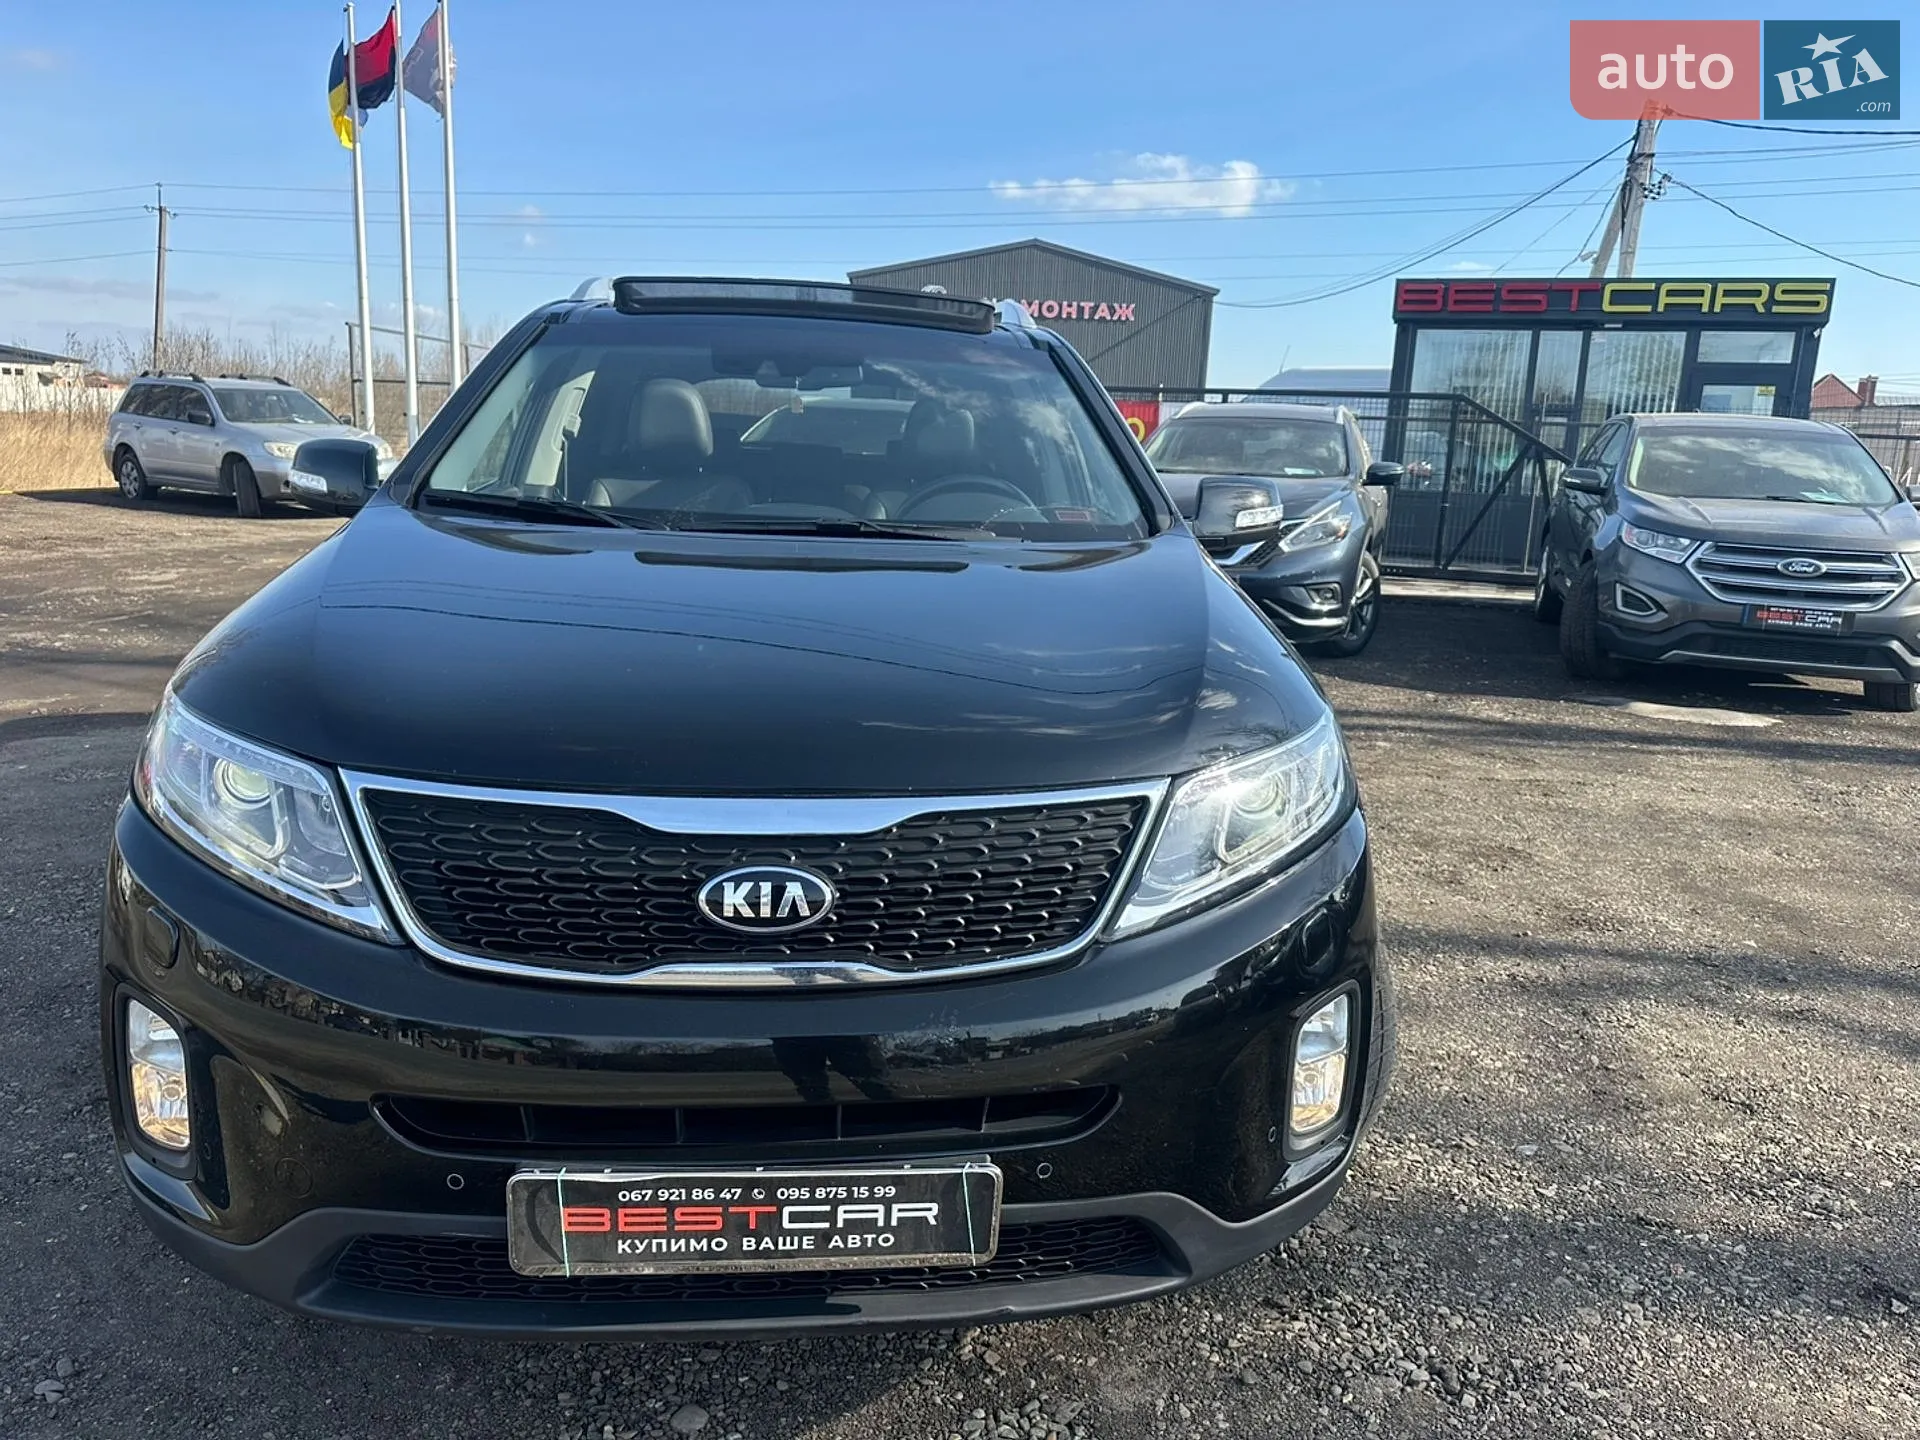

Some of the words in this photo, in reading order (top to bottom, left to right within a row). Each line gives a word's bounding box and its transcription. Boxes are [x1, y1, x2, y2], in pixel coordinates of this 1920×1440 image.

[984, 297, 1136, 321] МОНТАЖ
[1397, 282, 1831, 313] BESTCARS
[1788, 559, 1815, 573] Ford
[722, 881, 811, 918] KIA
[618, 1189, 653, 1202] 067
[657, 1188, 686, 1201] 921
[691, 1187, 715, 1200] 86
[719, 1187, 742, 1200] 47
[776, 1187, 811, 1200] 095
[814, 1186, 848, 1199] 875
[851, 1186, 870, 1198] 15
[873, 1185, 897, 1198] 99
[563, 1202, 939, 1232] BESTCAR
[617, 1236, 728, 1255] КУПИМО
[742, 1235, 815, 1251] ВАШЕ
[827, 1233, 895, 1249] АВТО
